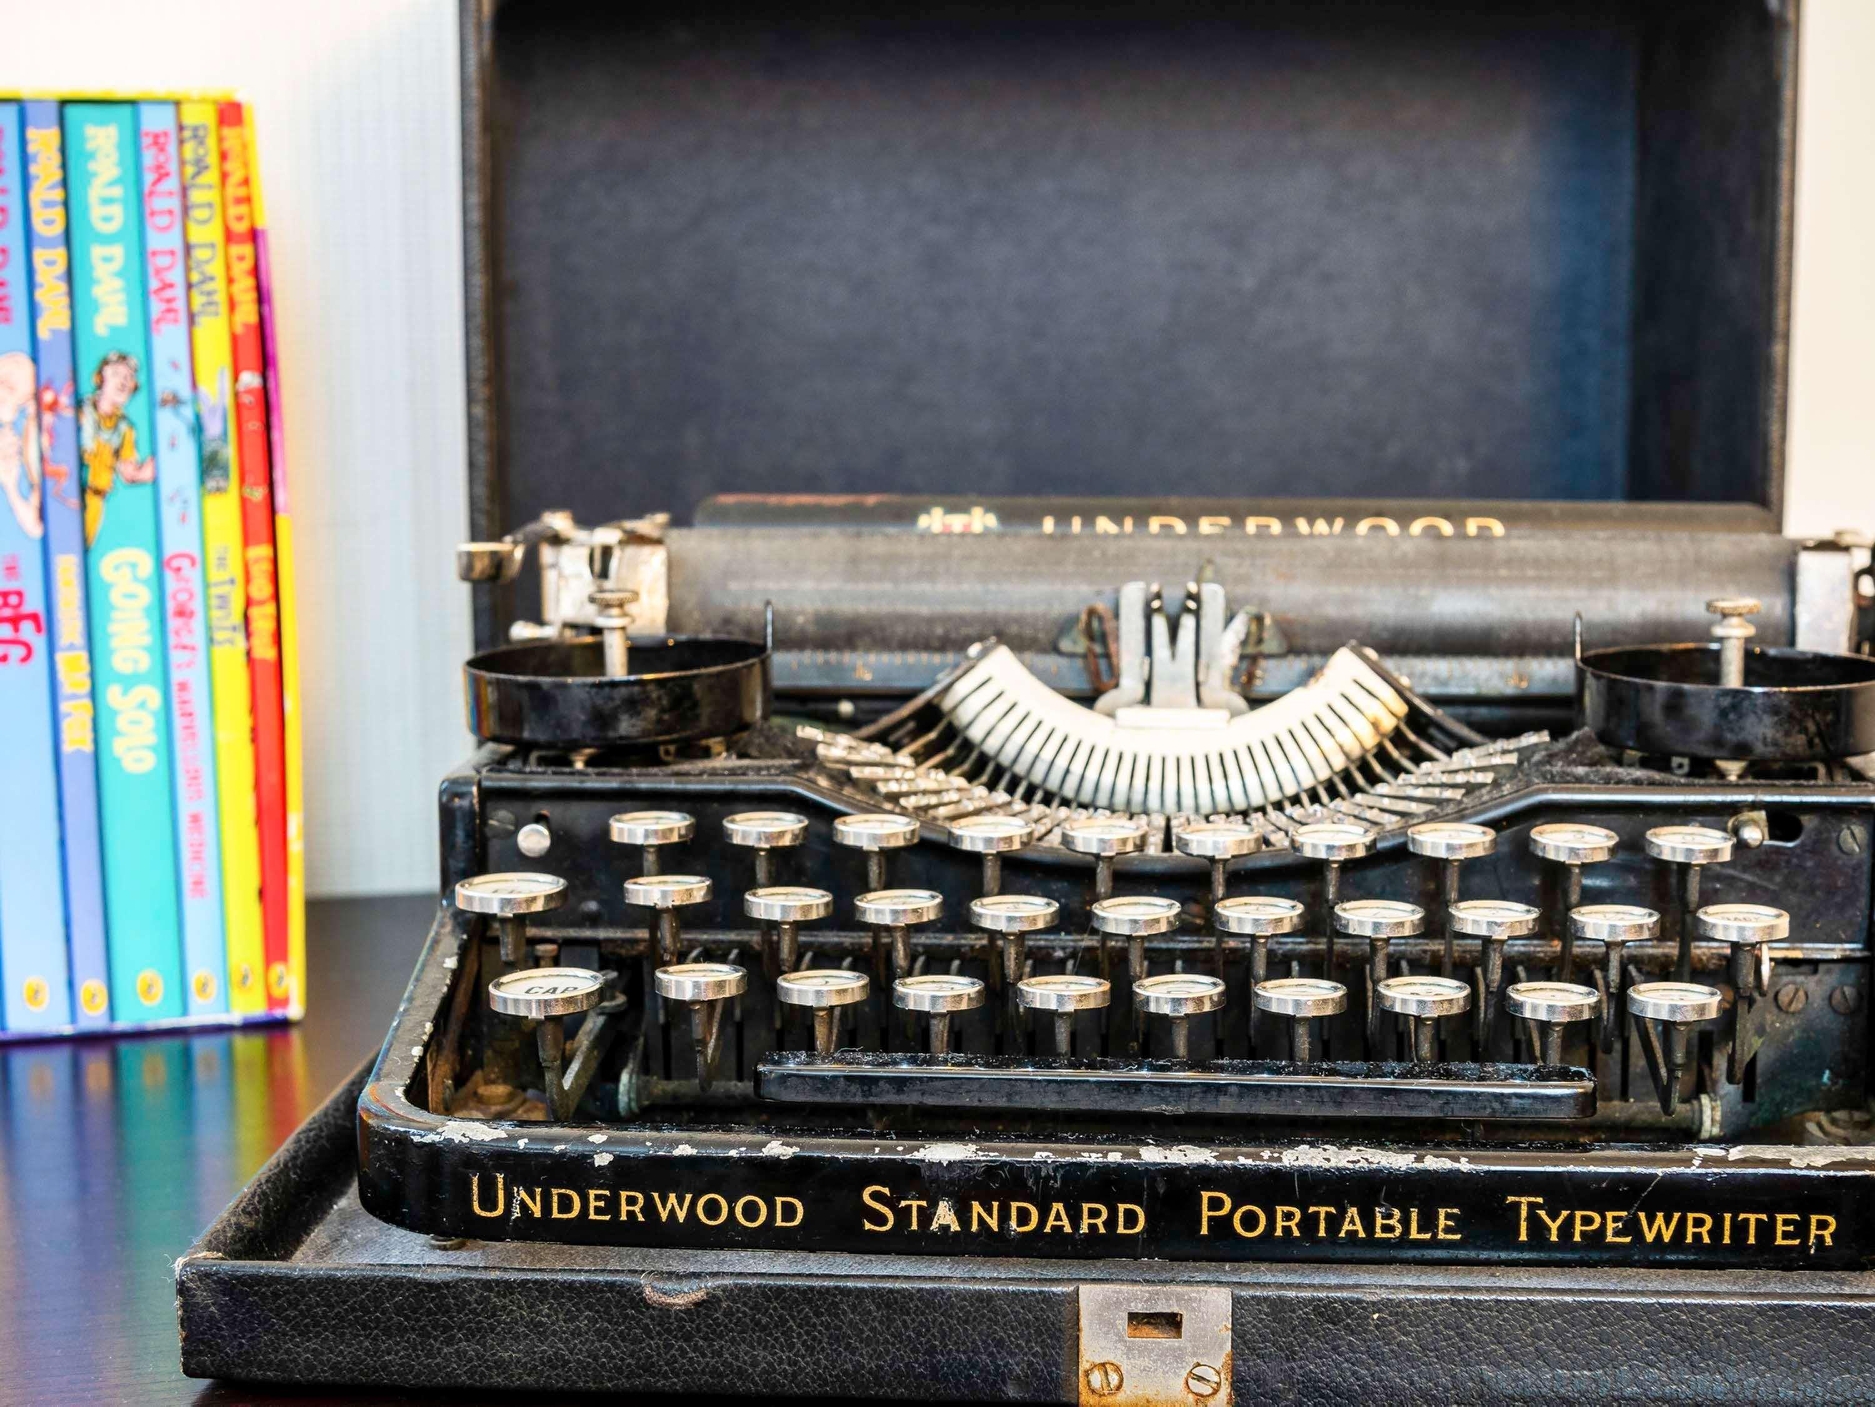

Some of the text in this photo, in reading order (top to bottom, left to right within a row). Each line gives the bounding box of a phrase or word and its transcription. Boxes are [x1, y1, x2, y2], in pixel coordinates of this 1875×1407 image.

[26, 127, 71, 339] ROALD DAHL
[84, 124, 127, 336] ROALD DAHL
[141, 130, 180, 335] ROALD DAHL
[181, 124, 219, 327] ROALD DAHL
[221, 127, 260, 333] ROALD DAHL
[99, 546, 161, 774] GOING SOLO
[470, 1172, 1838, 1249] UNDERWOOD STANDARD PORTABLE TYPEWRITER
